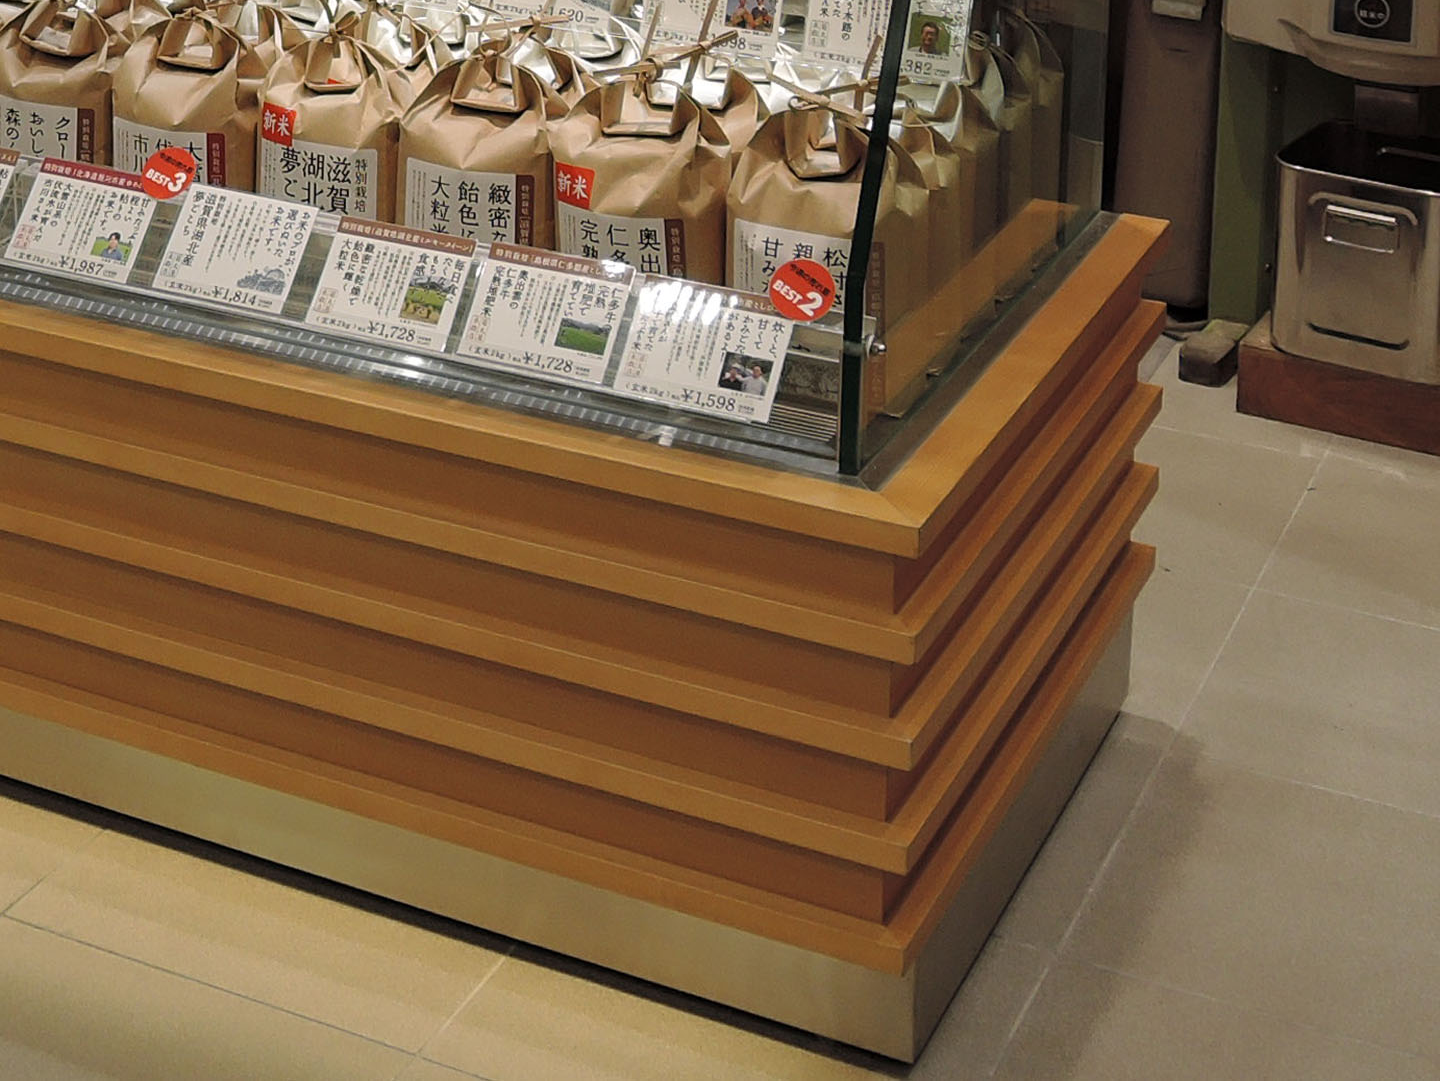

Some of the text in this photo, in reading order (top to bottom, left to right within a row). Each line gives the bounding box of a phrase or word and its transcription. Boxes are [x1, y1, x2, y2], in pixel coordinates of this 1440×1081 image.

[28, 111, 45, 156] おいし
[263, 112, 291, 138] 新米
[145, 167, 170, 187] BEST
[167, 172, 188, 193] 3
[280, 148, 301, 199] 夢ご
[302, 152, 326, 212] 湖北
[327, 155, 351, 215] 滋賀
[354, 158, 368, 212] 特別栽培
[556, 173, 589, 200] 新米
[182, 192, 218, 267] 滋賀県湖北産
[59, 255, 105, 276] ¥1,987
[638, 227, 662, 274] 奥出
[212, 285, 258, 306] ¥1,814
[772, 279, 824, 318] BEST 2
[367, 320, 416, 343] ¥1,728
[754, 318, 770, 350] 甘くて
[522, 351, 575, 374] ¥1,728
[681, 387, 737, 413] ¥1,598
